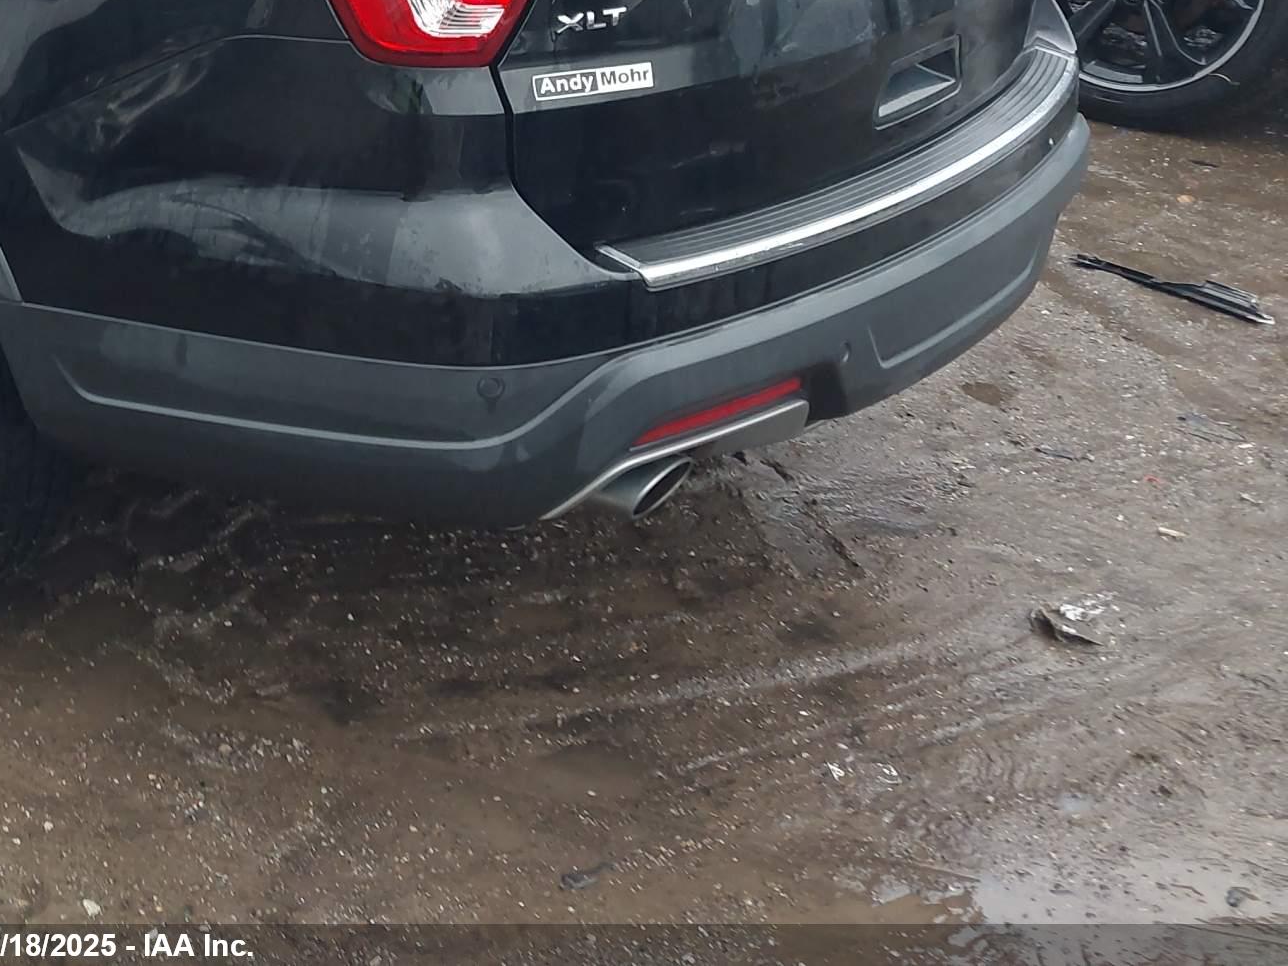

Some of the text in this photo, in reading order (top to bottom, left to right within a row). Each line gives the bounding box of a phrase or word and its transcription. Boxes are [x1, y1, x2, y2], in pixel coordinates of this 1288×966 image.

[556, 6, 628, 34] XLT
[539, 68, 650, 95] Andy Mohr
